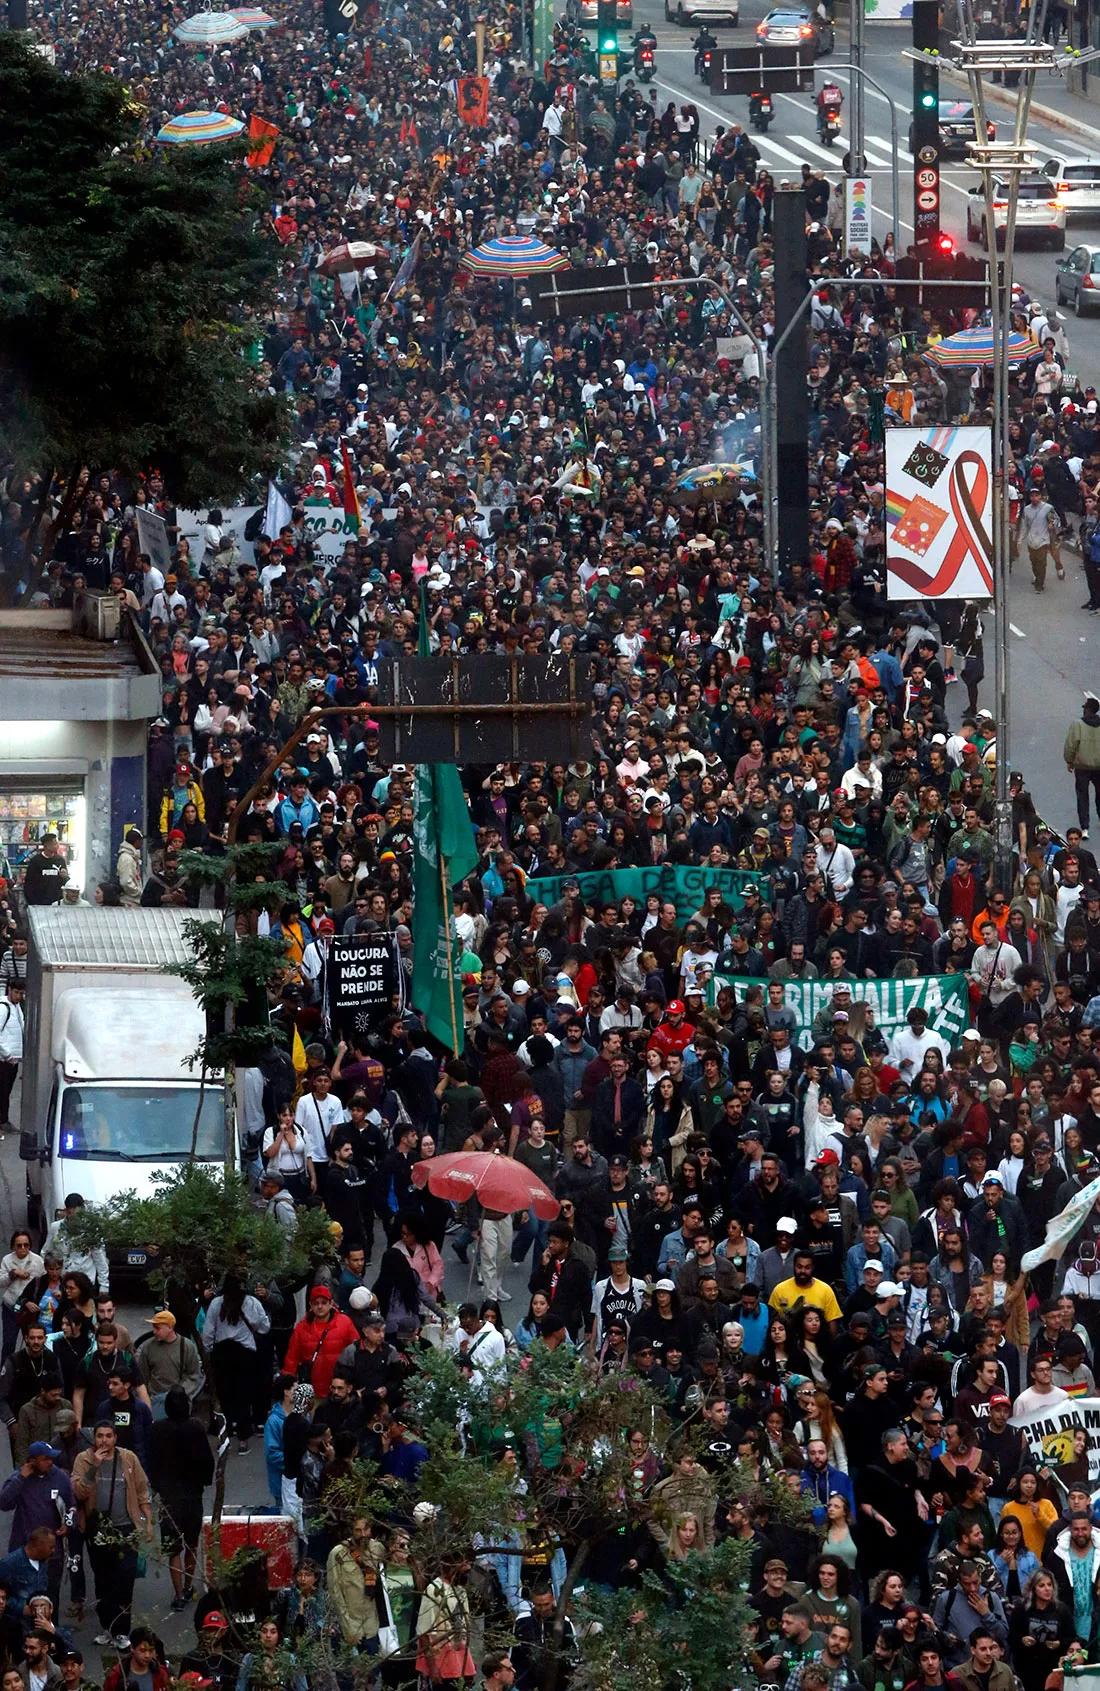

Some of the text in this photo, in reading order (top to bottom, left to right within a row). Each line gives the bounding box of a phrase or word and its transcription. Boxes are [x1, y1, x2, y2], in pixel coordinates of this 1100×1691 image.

[921, 173, 935, 183] 50
[334, 947, 390, 962] LOUCURA
[341, 964, 383, 979] NÃO SE
[341, 980, 384, 995] PRENDE
[1058, 1411, 1083, 1431] DA
